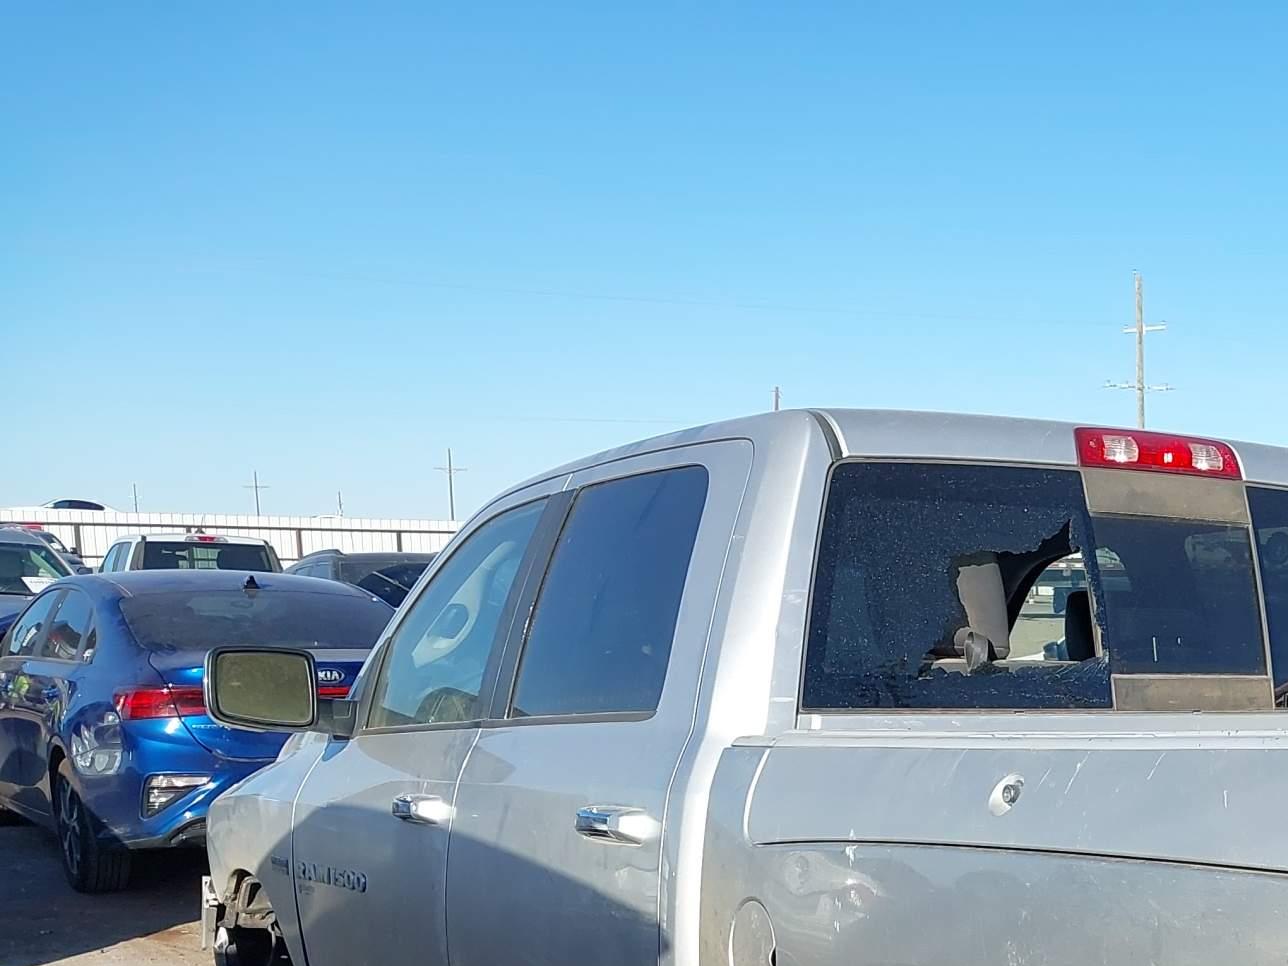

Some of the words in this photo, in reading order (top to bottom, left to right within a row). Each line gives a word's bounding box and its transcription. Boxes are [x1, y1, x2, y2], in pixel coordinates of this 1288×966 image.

[317, 670, 340, 681] KIA
[296, 862, 331, 885] RAM
[332, 867, 368, 893] 1500
